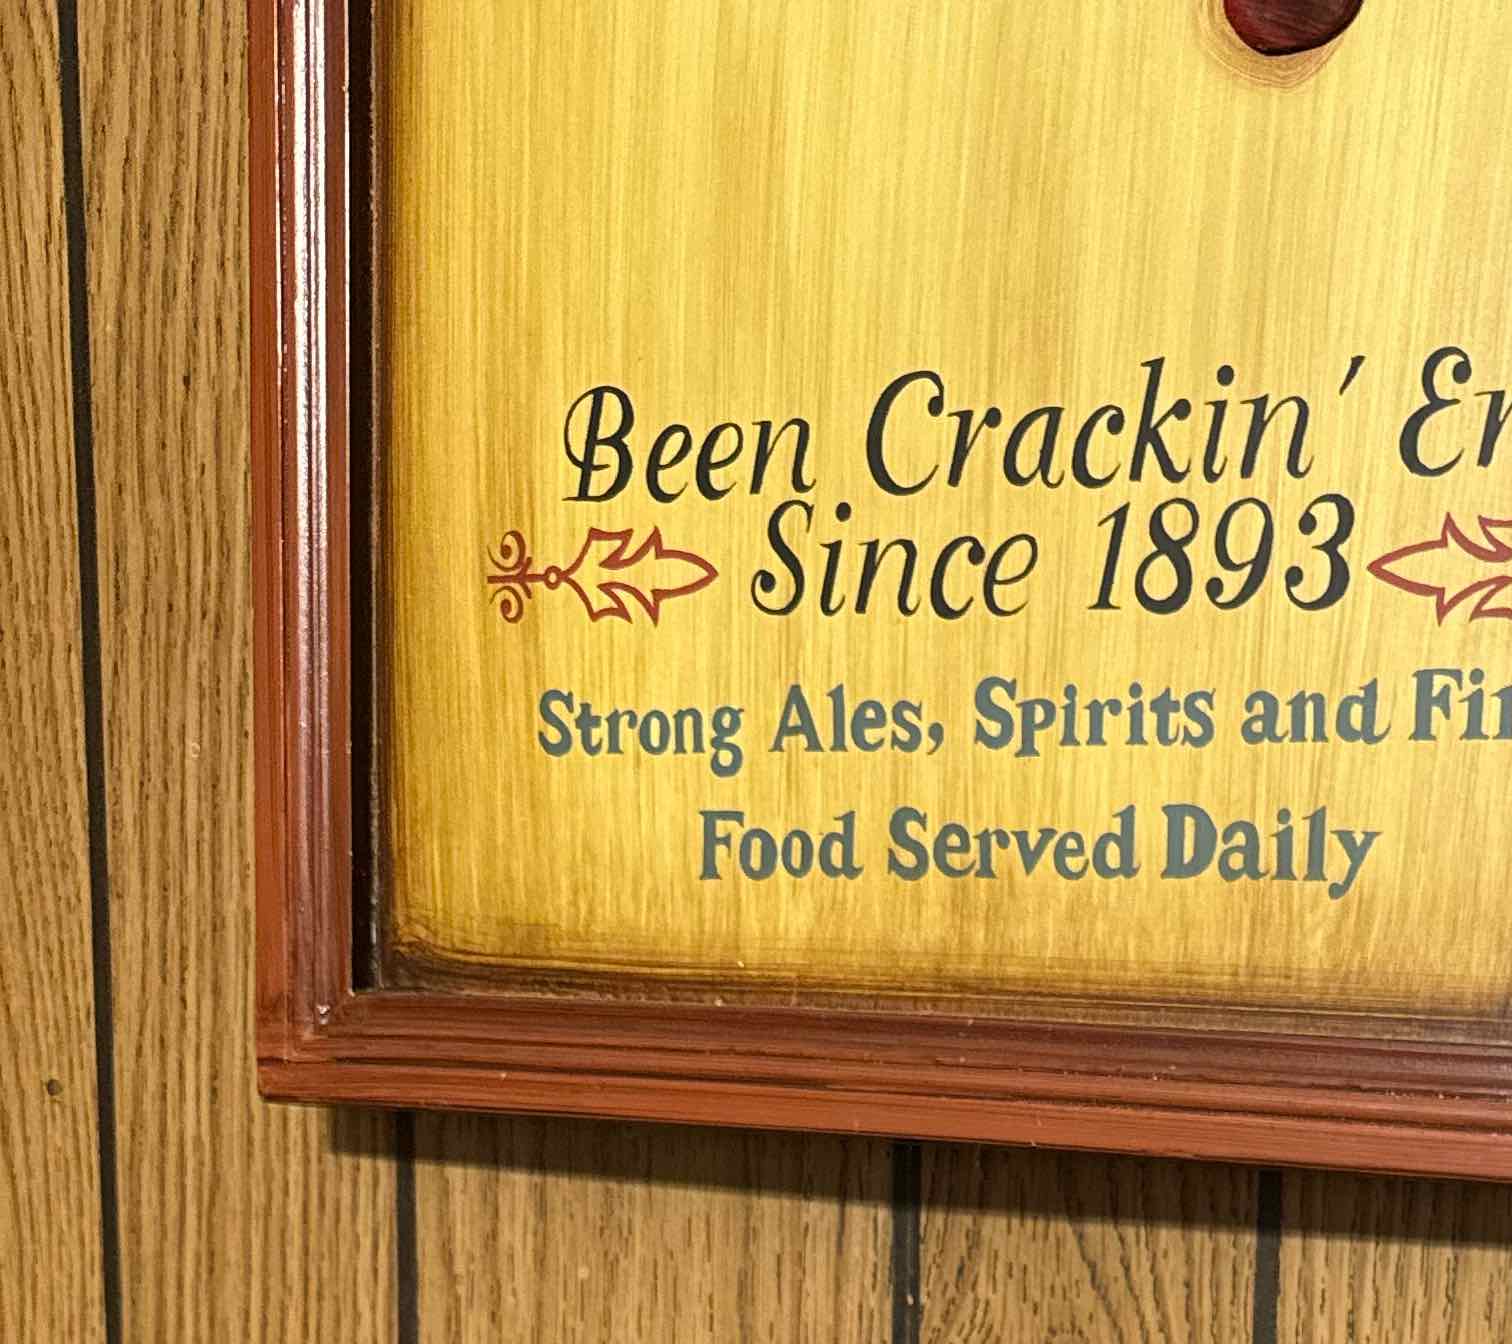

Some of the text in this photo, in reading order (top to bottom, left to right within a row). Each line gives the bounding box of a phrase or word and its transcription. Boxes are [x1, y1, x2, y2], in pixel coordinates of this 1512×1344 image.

[563, 384, 816, 502] Been
[866, 355, 1366, 496] Crackin'
[751, 493, 1355, 620] Since 1893
[538, 689, 744, 777] Strong
[769, 683, 945, 756] Ales,
[974, 677, 1216, 758] Spirits
[1241, 678, 1392, 745] and
[699, 803, 1382, 899] Food Served Daily
